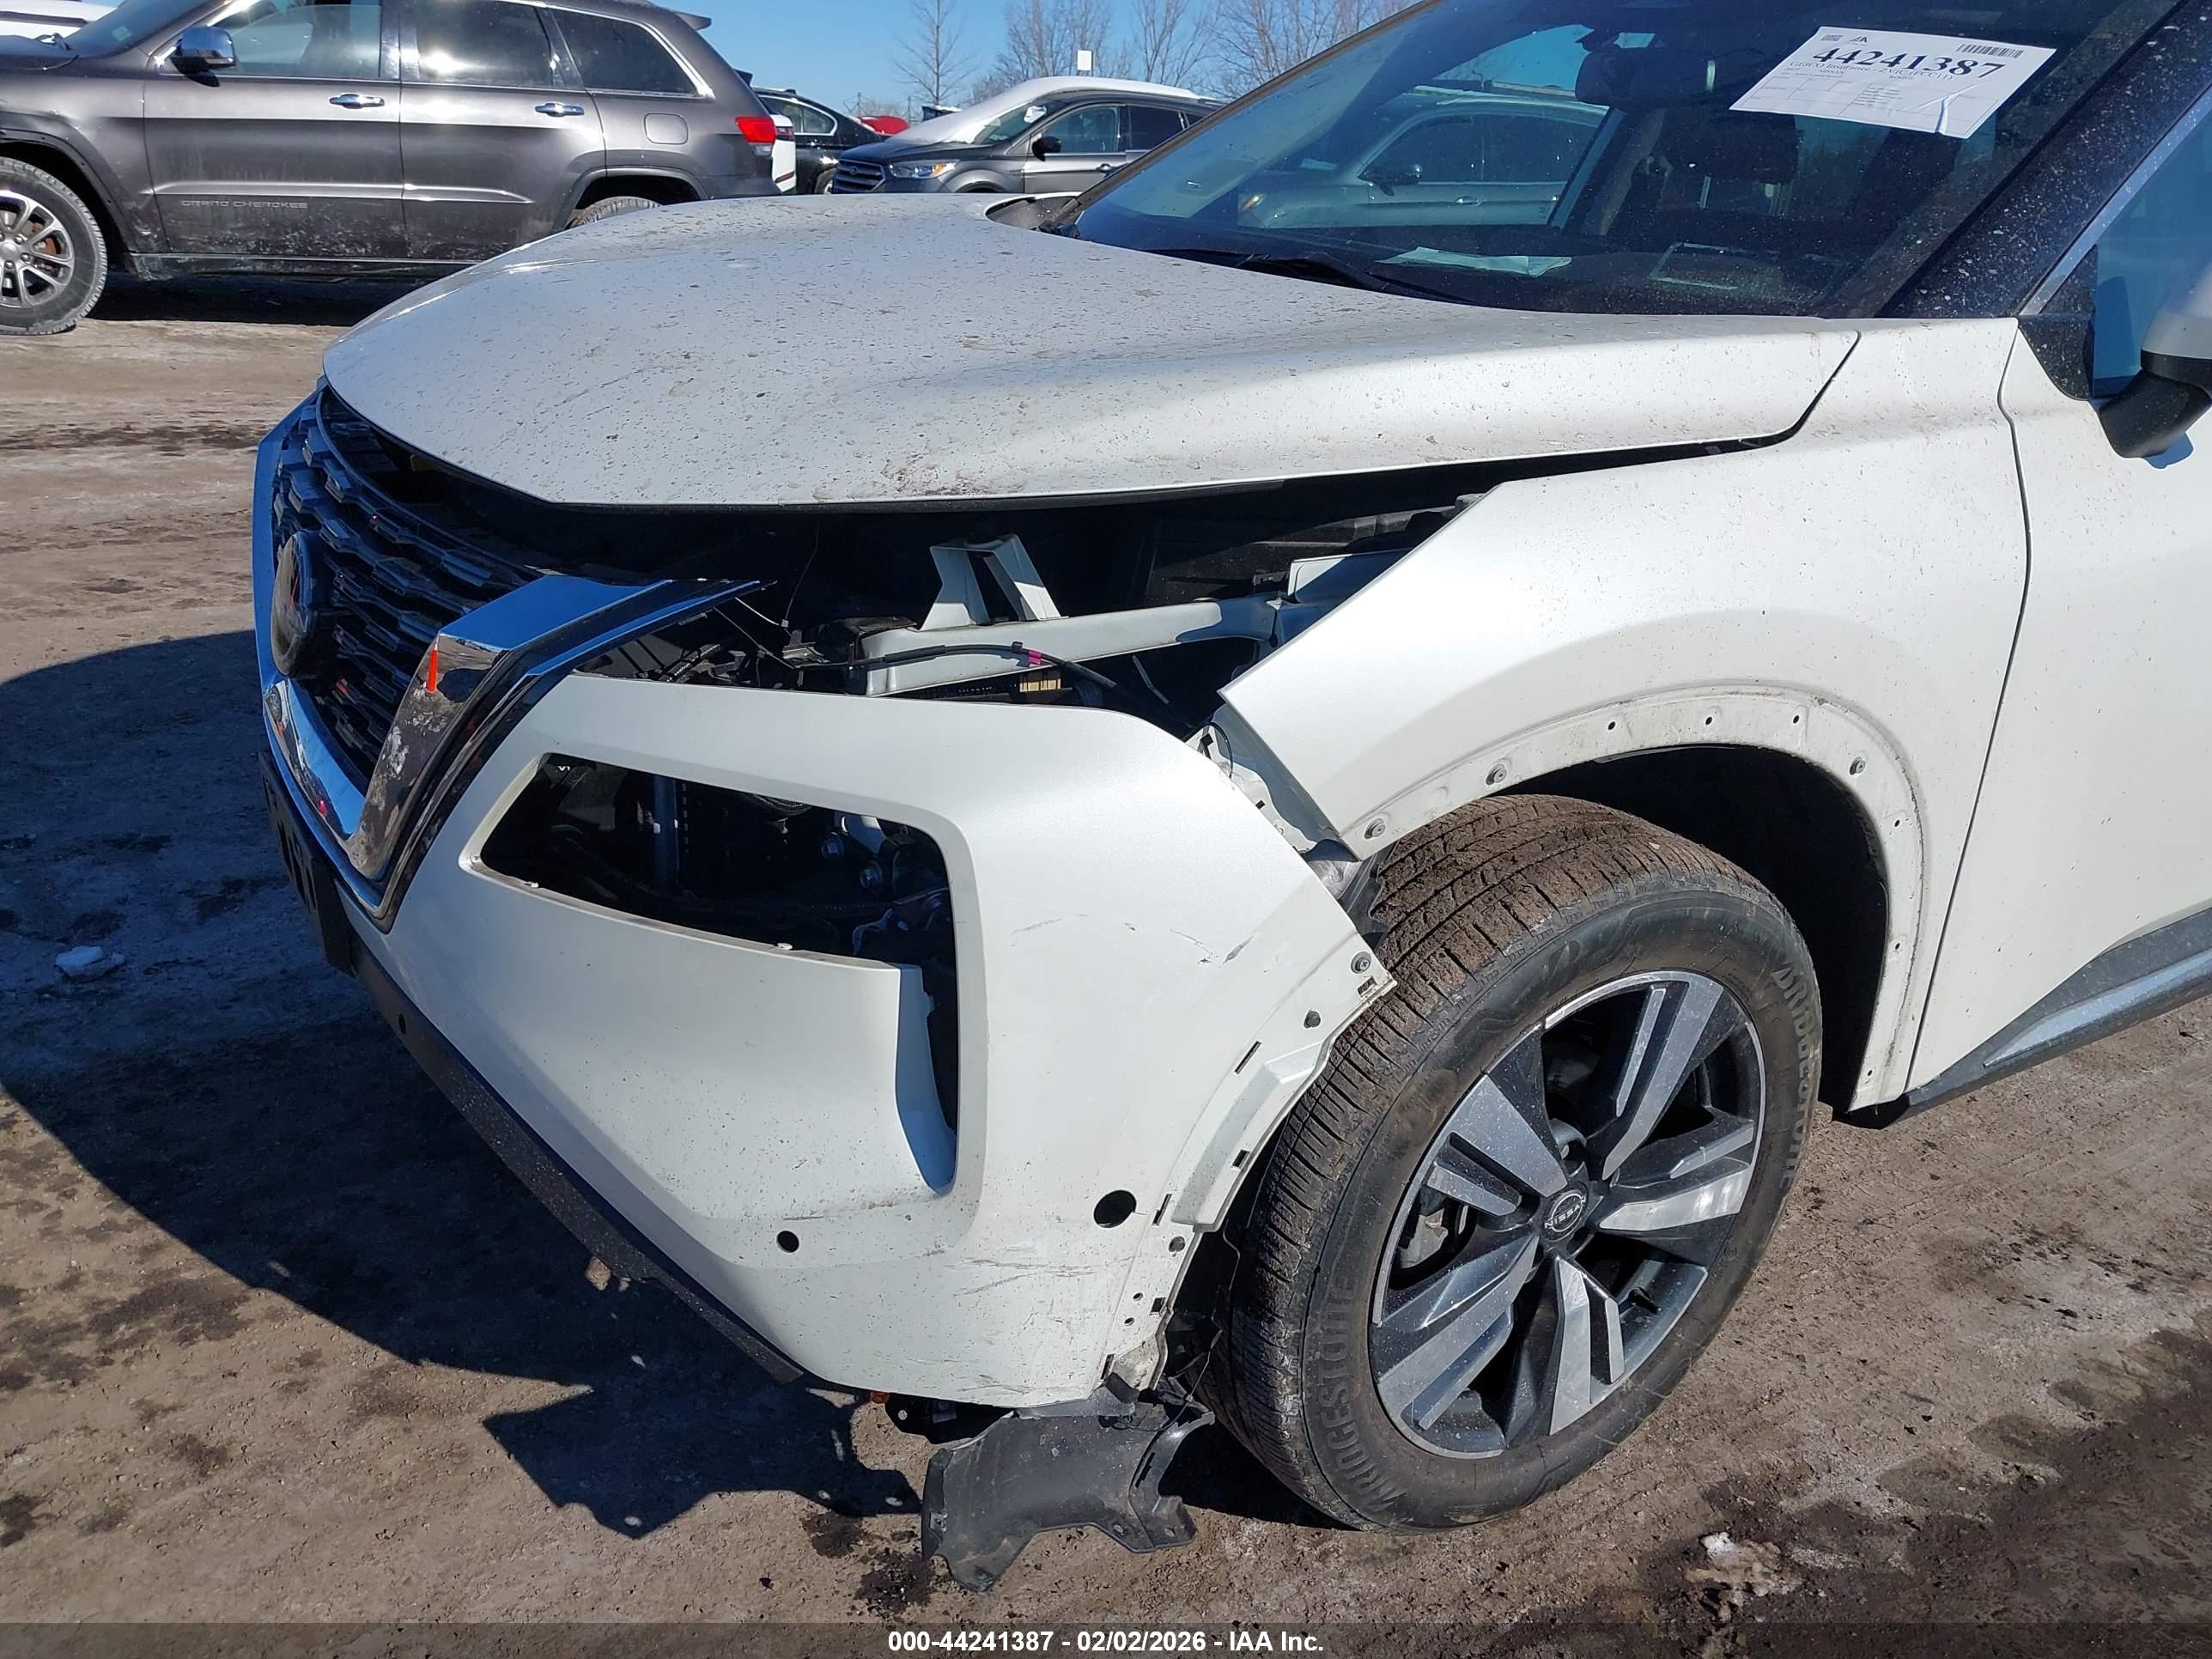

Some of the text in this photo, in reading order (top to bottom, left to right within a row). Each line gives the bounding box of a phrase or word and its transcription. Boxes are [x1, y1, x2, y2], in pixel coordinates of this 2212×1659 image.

[1812, 46, 2007, 79] 44241387
[1826, 62, 1871, 71] Insurance
[233, 200, 308, 209] CHEROKEE
[1544, 1195, 1587, 1230] NISSAN
